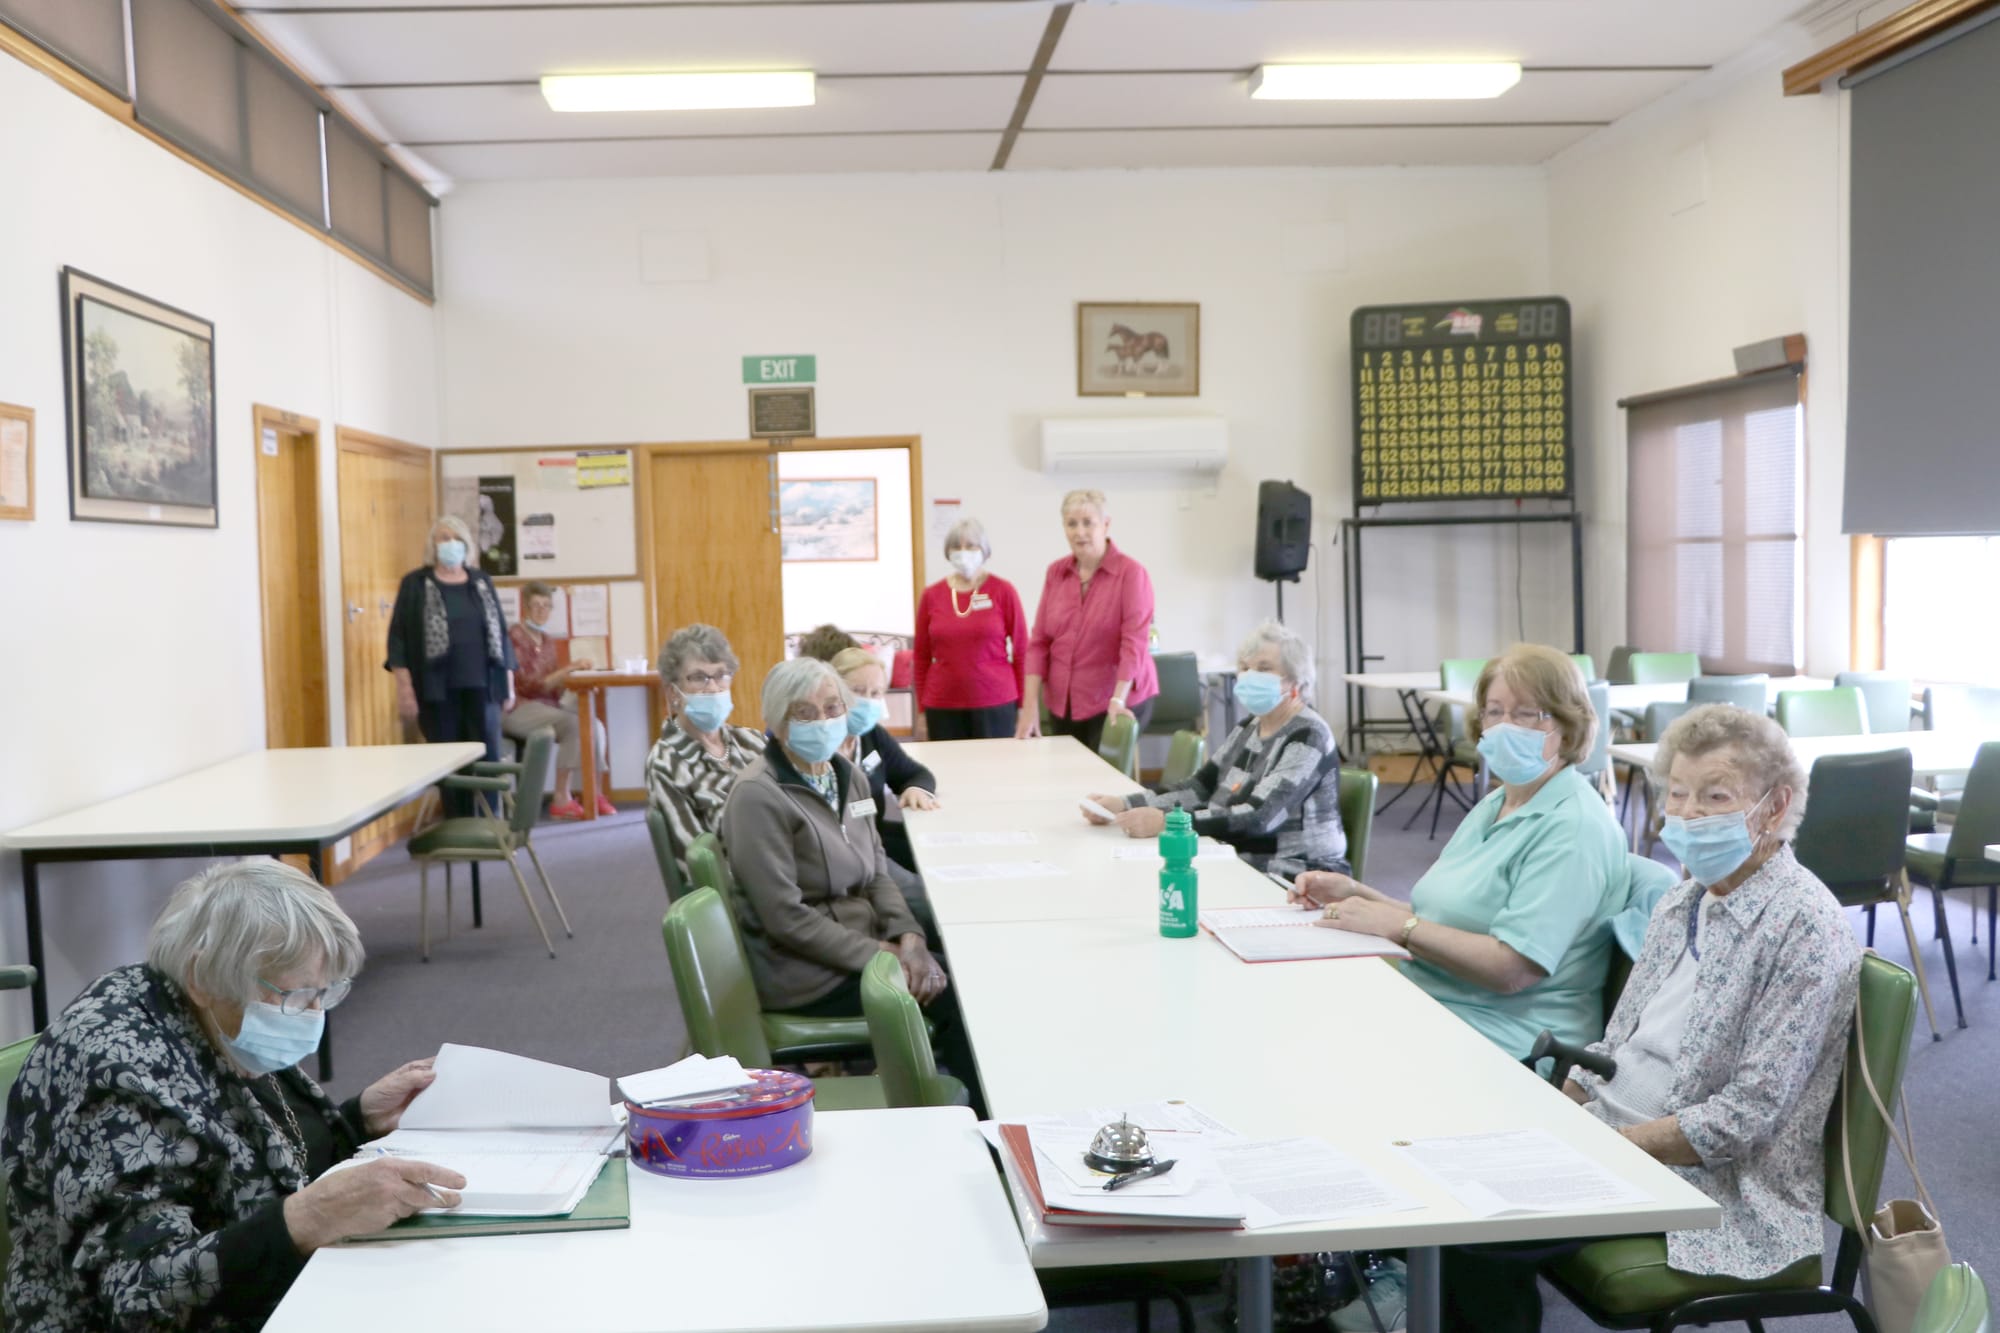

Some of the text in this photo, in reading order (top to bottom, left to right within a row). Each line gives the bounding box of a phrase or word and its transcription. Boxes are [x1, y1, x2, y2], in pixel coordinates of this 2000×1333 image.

[1363, 344, 1562, 368] 1 2 3 4 5 6 7 8 9 10
[760, 359, 797, 379] EXIT
[1360, 361, 1563, 384] 11 12 13 14 15 16 17 18 19 20
[1362, 476, 1564, 496] 81 82 83 84 85 86 87 88 89 90
[689, 1132, 767, 1167] Roses
